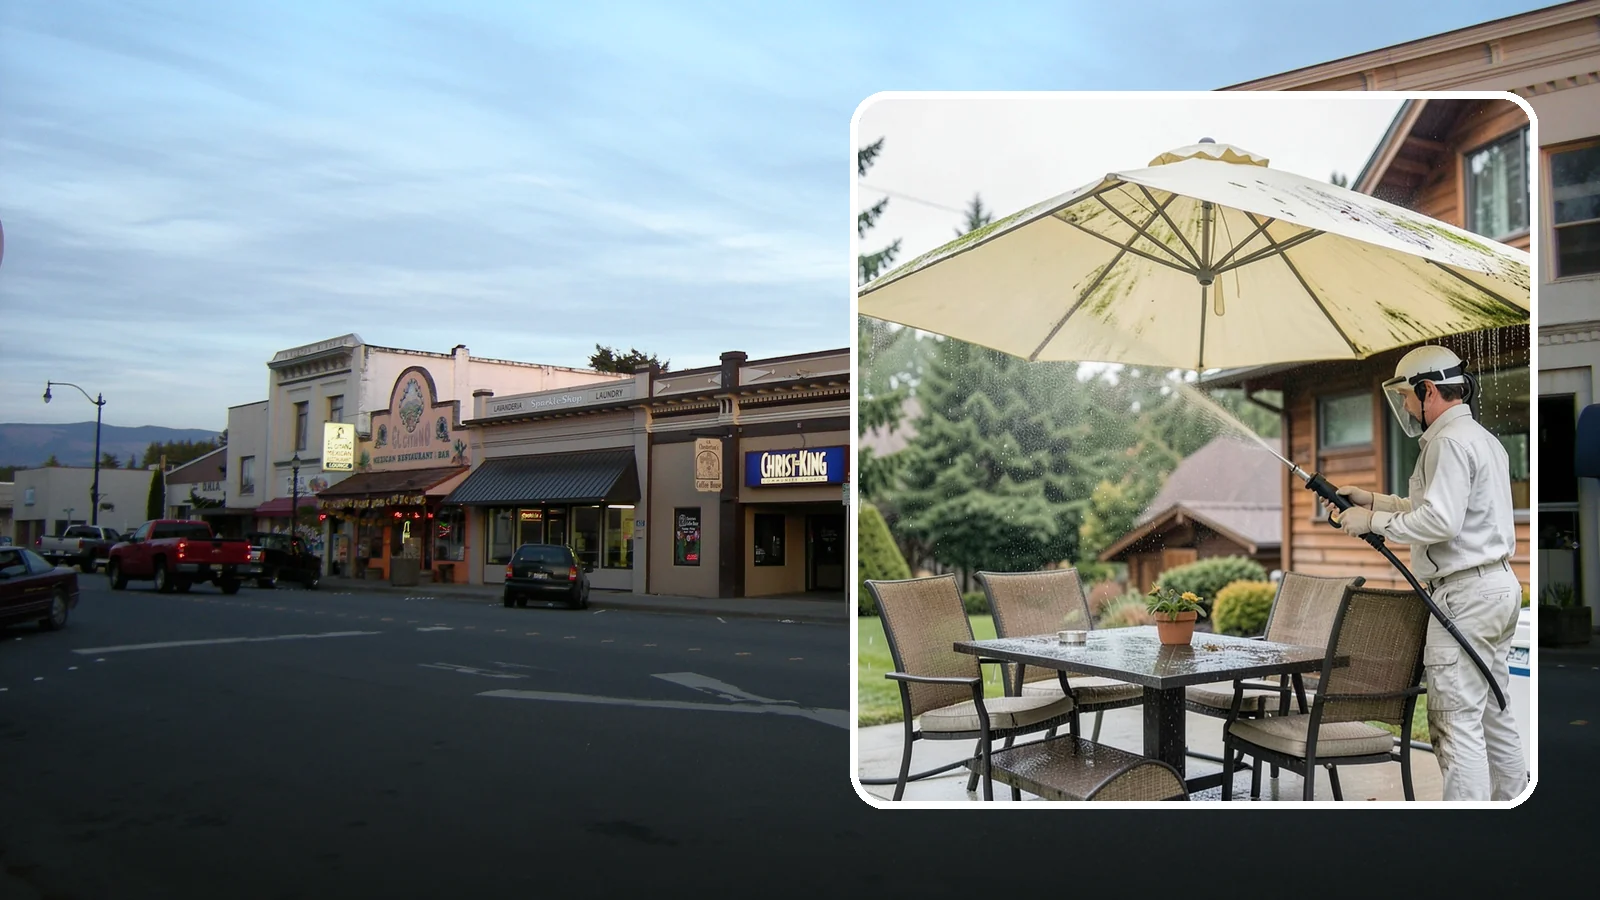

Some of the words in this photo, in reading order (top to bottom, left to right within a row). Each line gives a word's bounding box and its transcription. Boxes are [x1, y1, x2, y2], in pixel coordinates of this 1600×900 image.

[562, 394, 582, 405] Shop
[595, 389, 623, 400] LAUNDRY
[493, 402, 522, 413] LAVANDERIA
[373, 454, 396, 465] MEXICAN
[397, 451, 433, 463] RESTAURANT
[437, 449, 450, 459] BAR
[760, 452, 797, 478] CHRIST
[799, 450, 827, 476] KING
